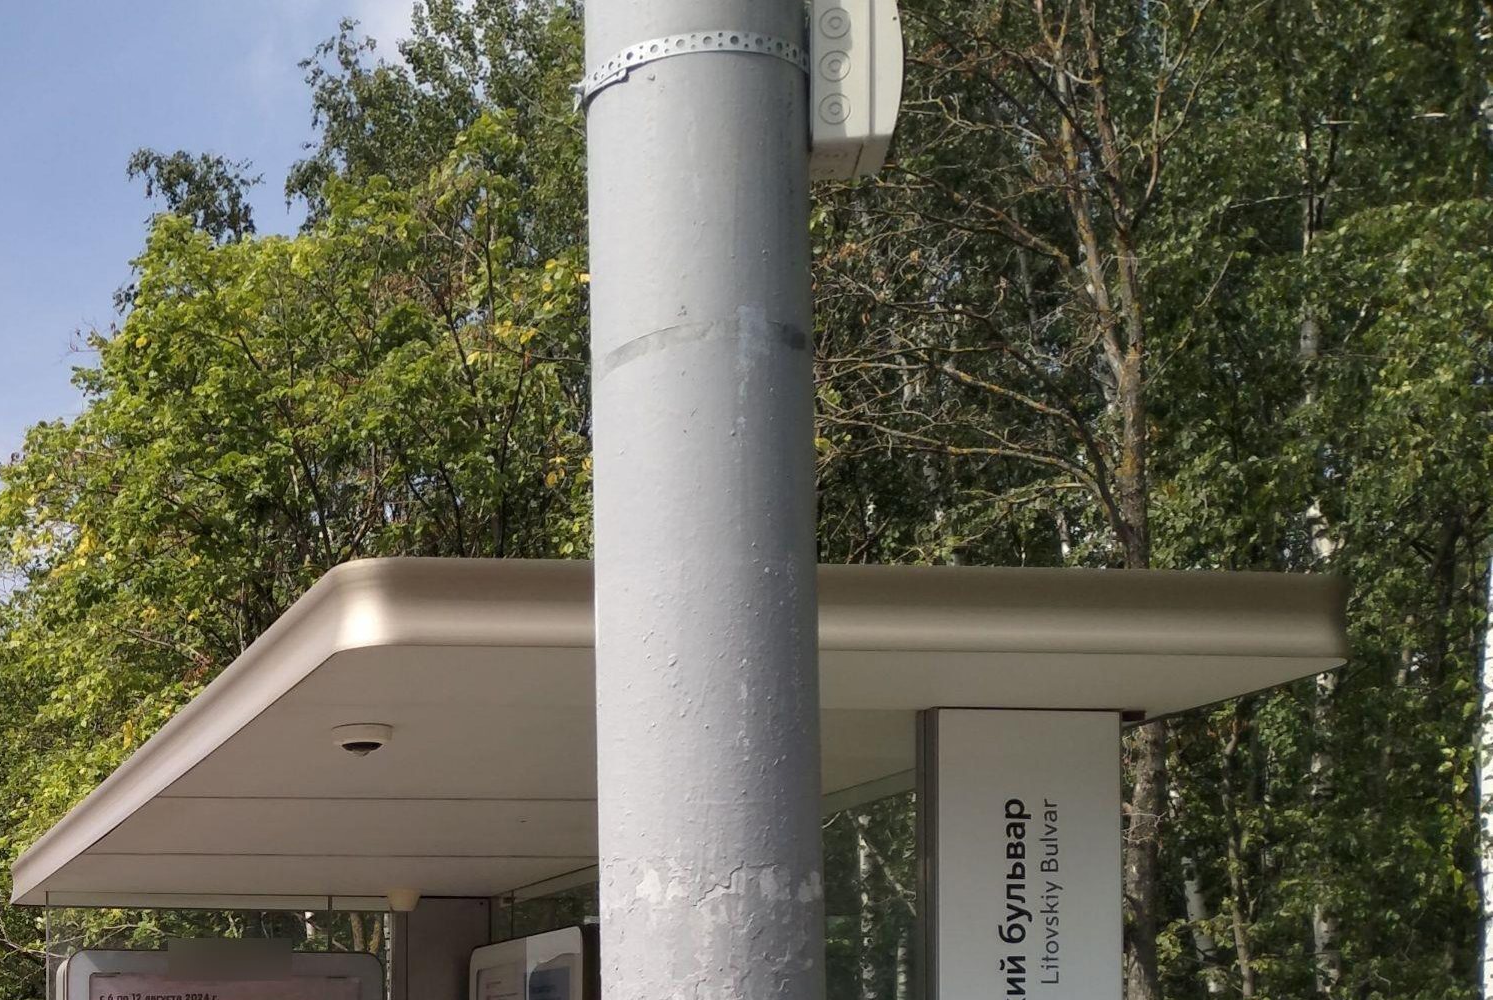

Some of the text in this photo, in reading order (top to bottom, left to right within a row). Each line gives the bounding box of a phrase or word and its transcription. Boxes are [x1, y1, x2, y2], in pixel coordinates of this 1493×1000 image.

[998, 799, 1032, 944] бульвар
[1039, 798, 1063, 984] Litovskiy Bulvar
